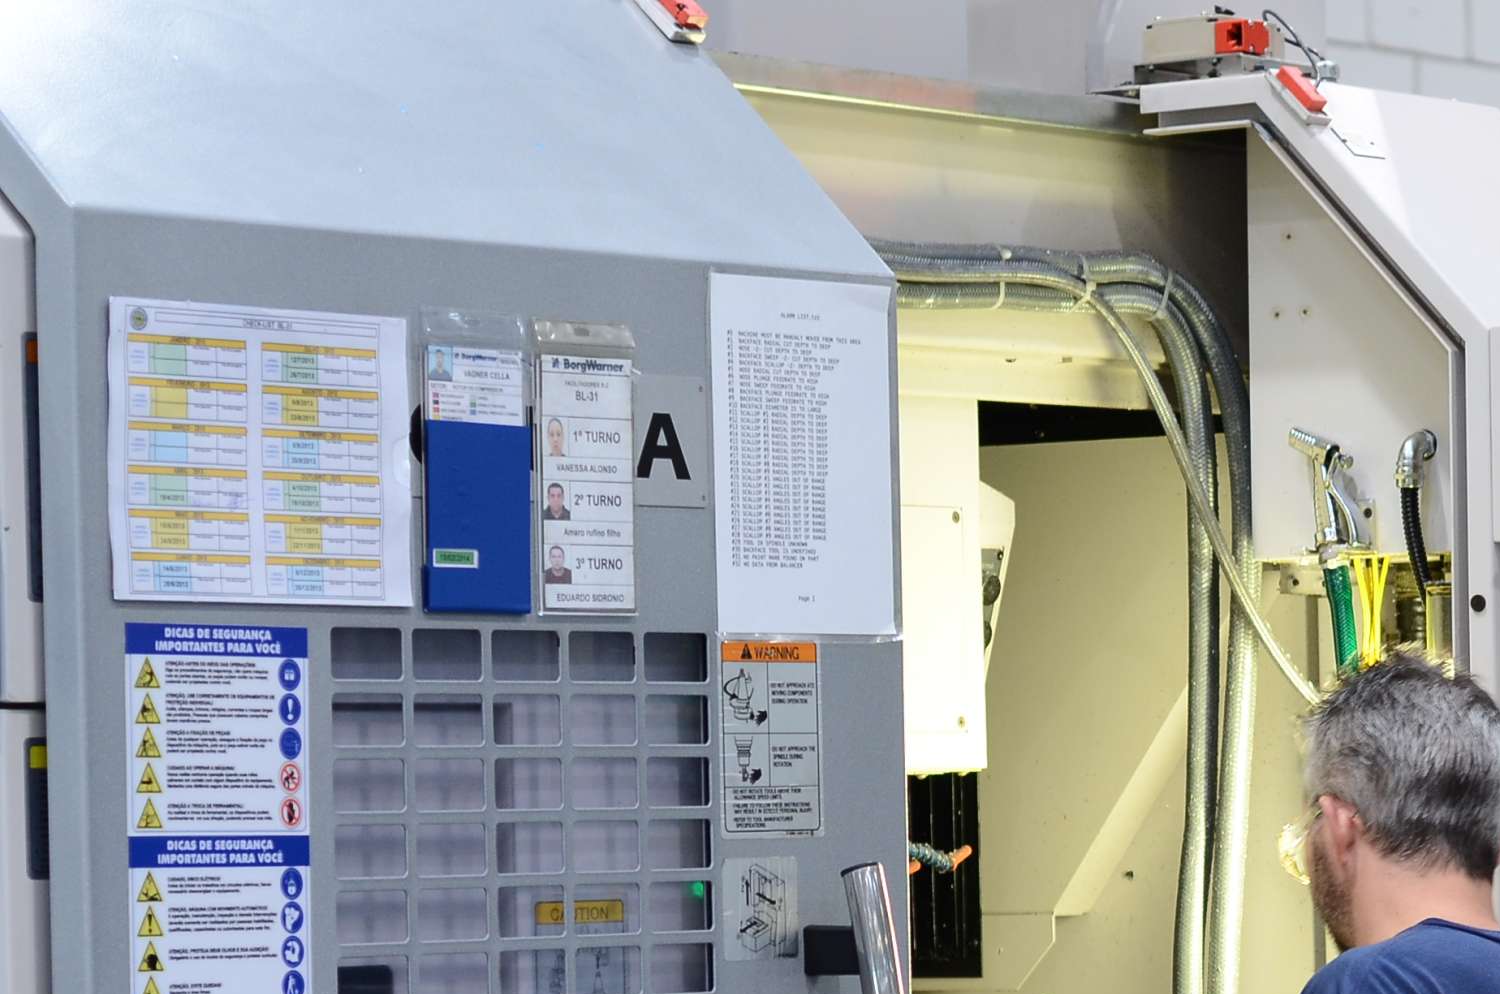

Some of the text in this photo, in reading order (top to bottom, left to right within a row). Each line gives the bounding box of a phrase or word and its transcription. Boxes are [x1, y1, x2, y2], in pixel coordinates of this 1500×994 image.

[563, 358, 624, 372] BorgWarner
[575, 390, 599, 401] BL-31
[585, 431, 621, 444] TURNO
[637, 413, 691, 480] A
[556, 464, 588, 473] VANESSA
[587, 495, 622, 507] TURNO
[588, 558, 622, 570] TURNO
[556, 593, 590, 602] EDUARDO
[164, 627, 272, 641] DICAS DE SEGURANÇA
[155, 640, 280, 654] IMPORTANTES PARA VOCÊ
[754, 647, 800, 660] WARNING
[167, 839, 274, 852] DICAS DE SEGURANÇA
[158, 850, 284, 864] IMPORTANTES PARA VOCÊ
[551, 905, 609, 922] CTION
